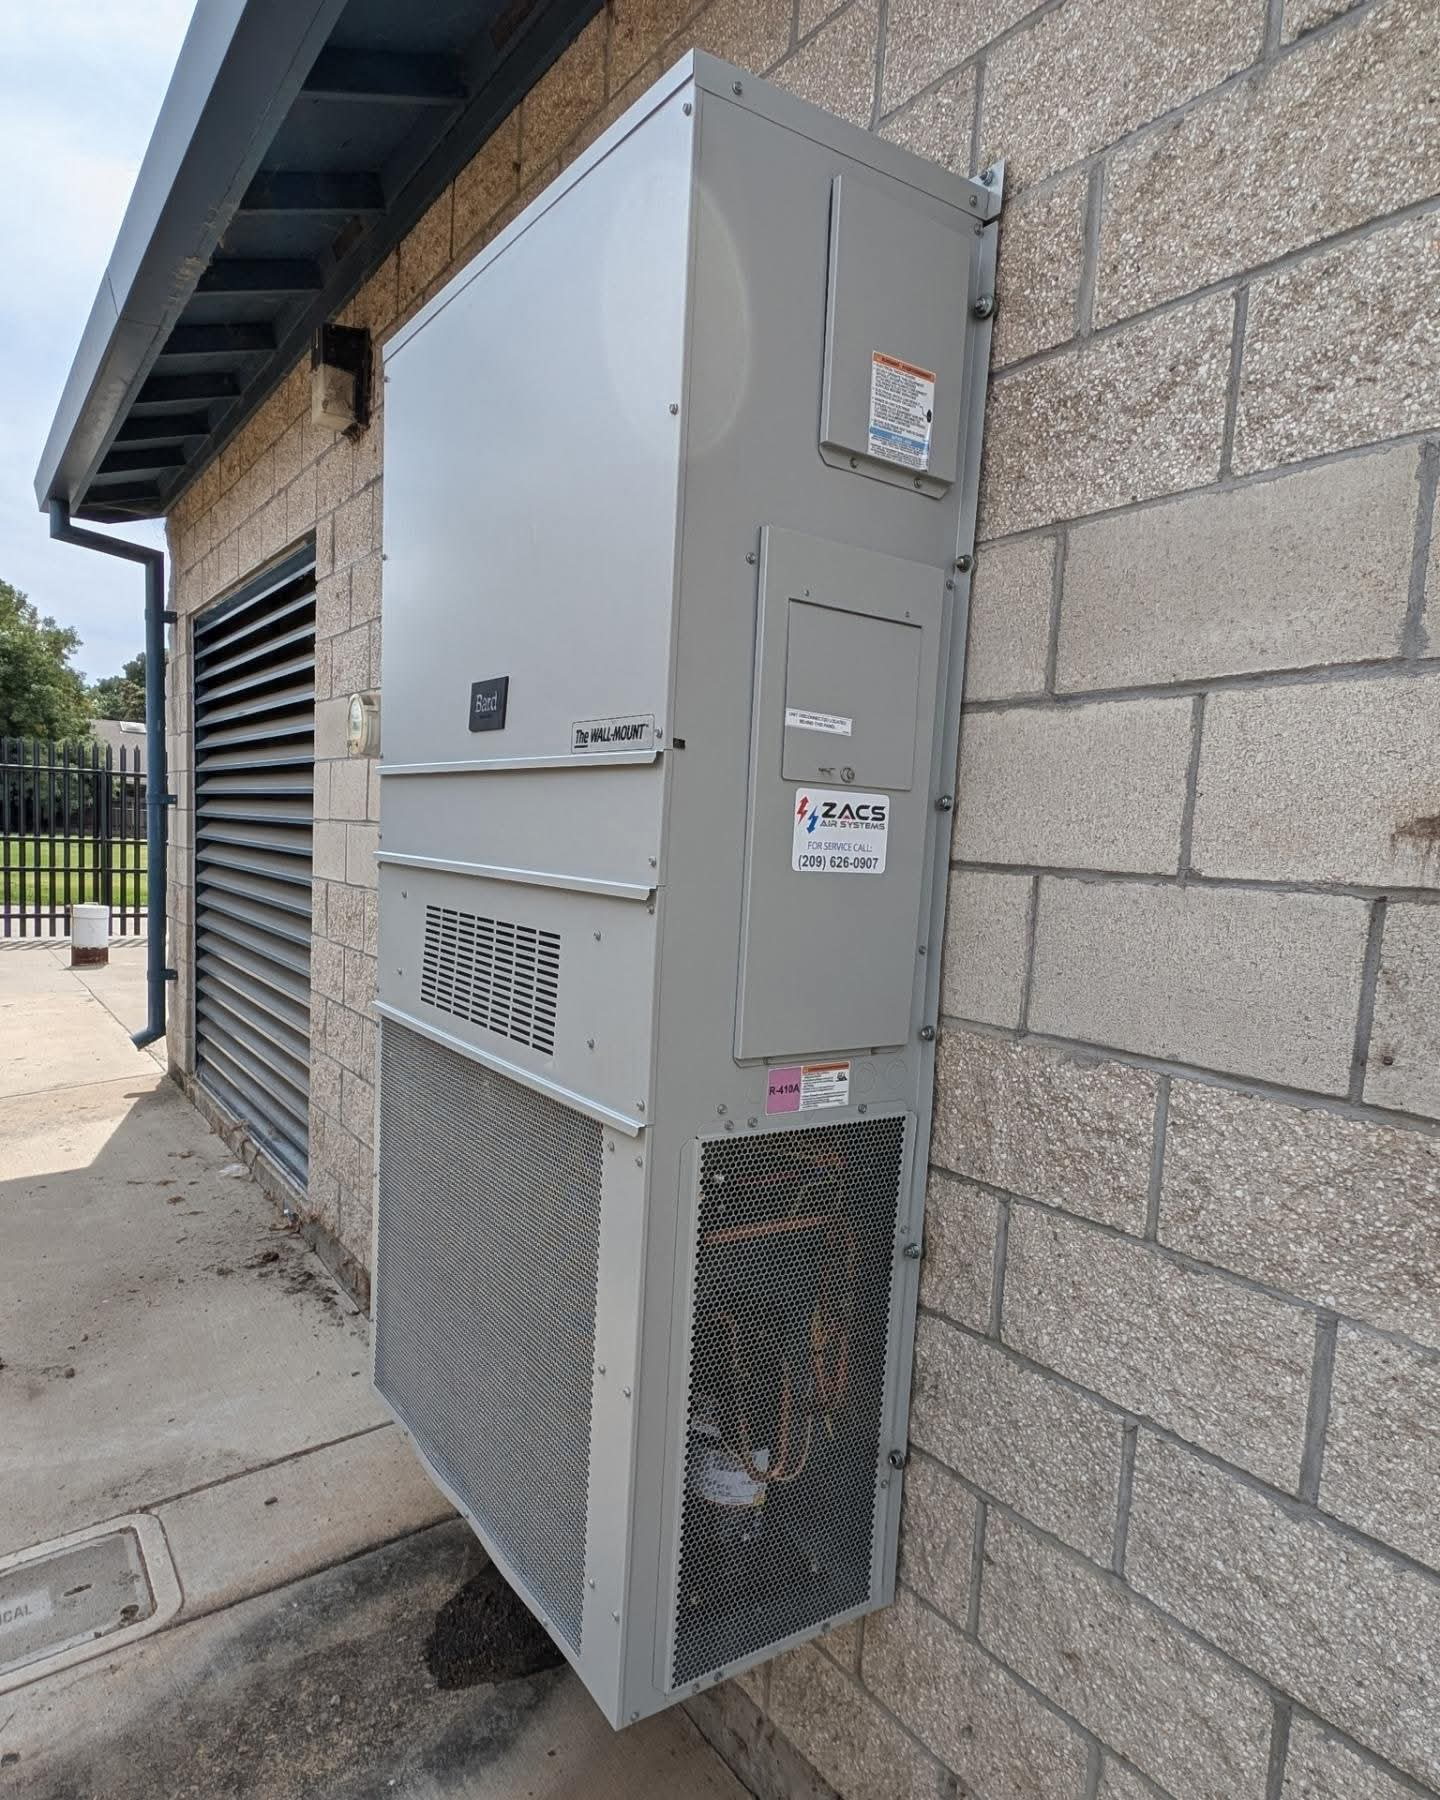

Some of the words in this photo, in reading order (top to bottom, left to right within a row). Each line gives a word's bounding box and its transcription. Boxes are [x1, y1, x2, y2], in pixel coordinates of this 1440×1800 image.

[475, 691, 498, 713] Bard
[575, 729, 589, 745] The
[822, 802, 886, 822] ZACS
[820, 820, 838, 828] AIR
[839, 821, 886, 830] SYSTEMS
[807, 841, 823, 850] FOR
[823, 841, 852, 852] SERVICE
[853, 843, 873, 853] CALL:
[798, 854, 827, 871] (209)
[829, 856, 879, 870] 626-0907
[769, 1084, 801, 1096] R-410A
